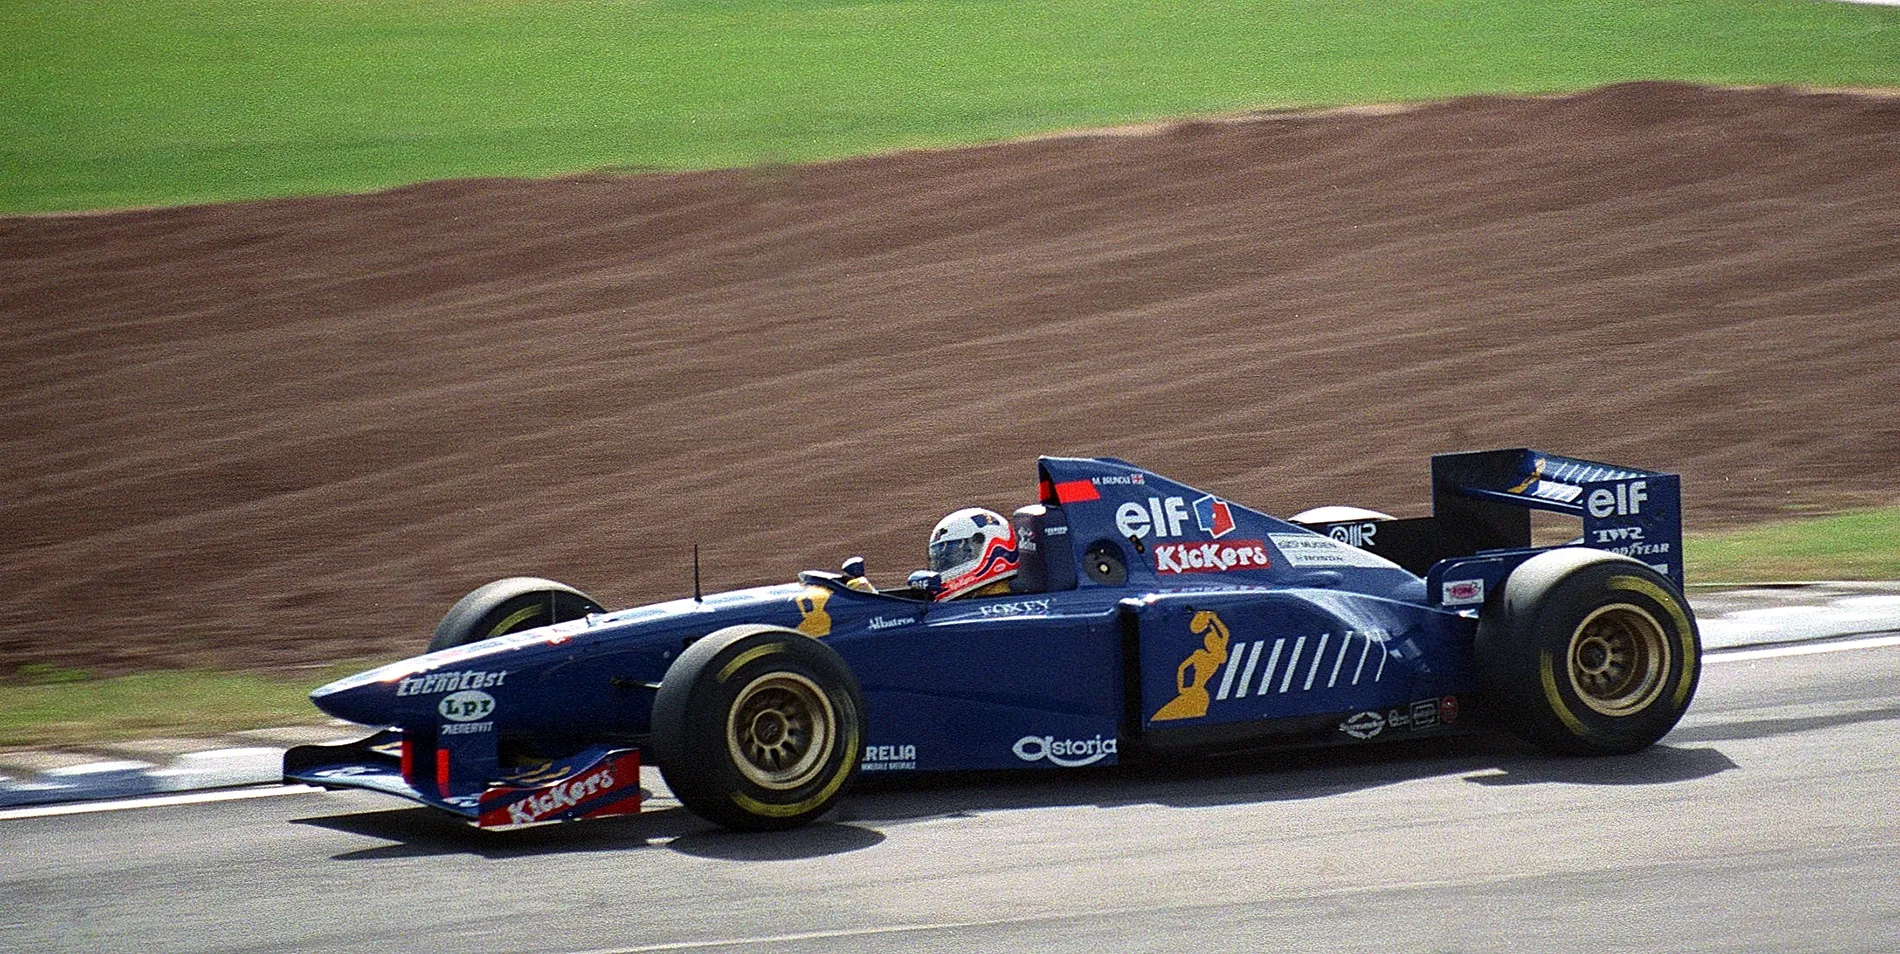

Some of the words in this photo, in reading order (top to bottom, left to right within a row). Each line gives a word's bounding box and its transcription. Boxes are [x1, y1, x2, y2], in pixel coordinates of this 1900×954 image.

[1588, 481, 1648, 518] elf
[1115, 497, 1189, 540] elf
[1592, 527, 1645, 543] TWR
[863, 745, 916, 761] RELIA
